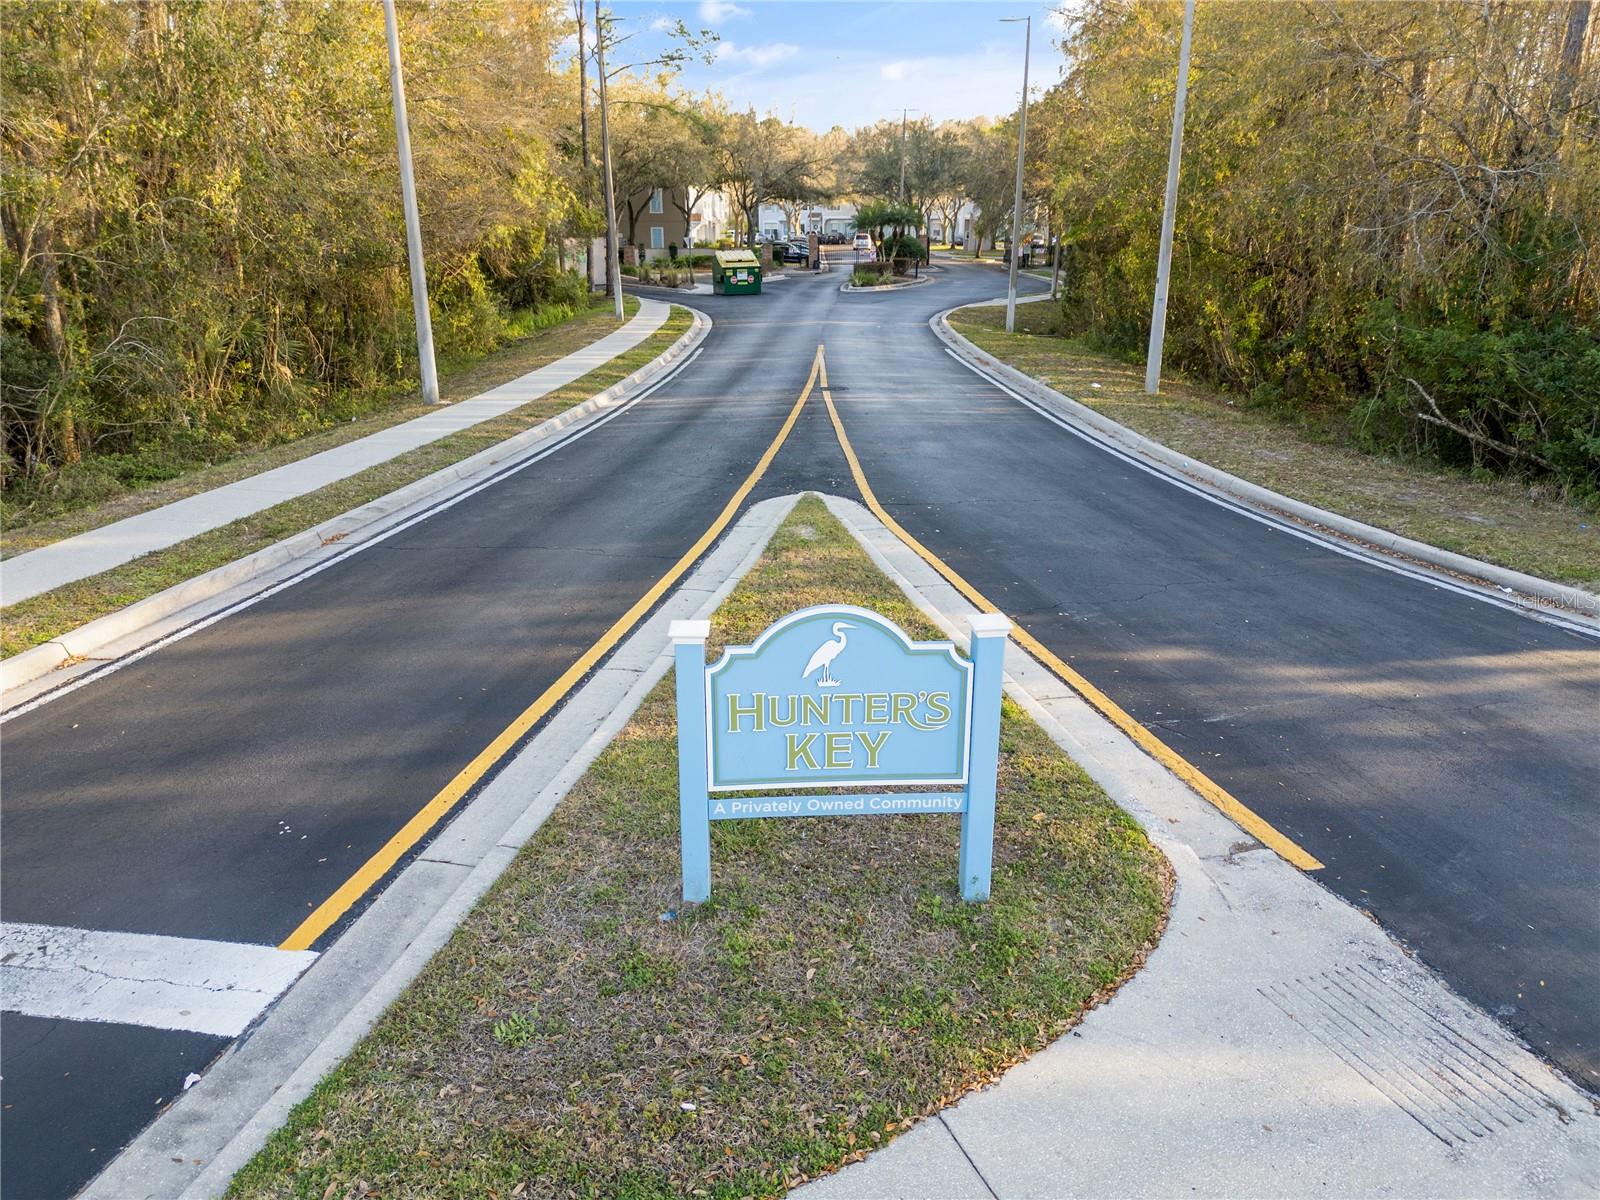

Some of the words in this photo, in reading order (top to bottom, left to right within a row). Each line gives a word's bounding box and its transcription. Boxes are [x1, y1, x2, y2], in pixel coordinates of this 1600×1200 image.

[726, 690, 952, 733] HUNTER'S
[785, 730, 892, 770] KEY
[713, 802, 726, 815] A
[731, 798, 802, 815] Privately
[807, 797, 865, 811] Owned
[869, 795, 963, 811] Community
